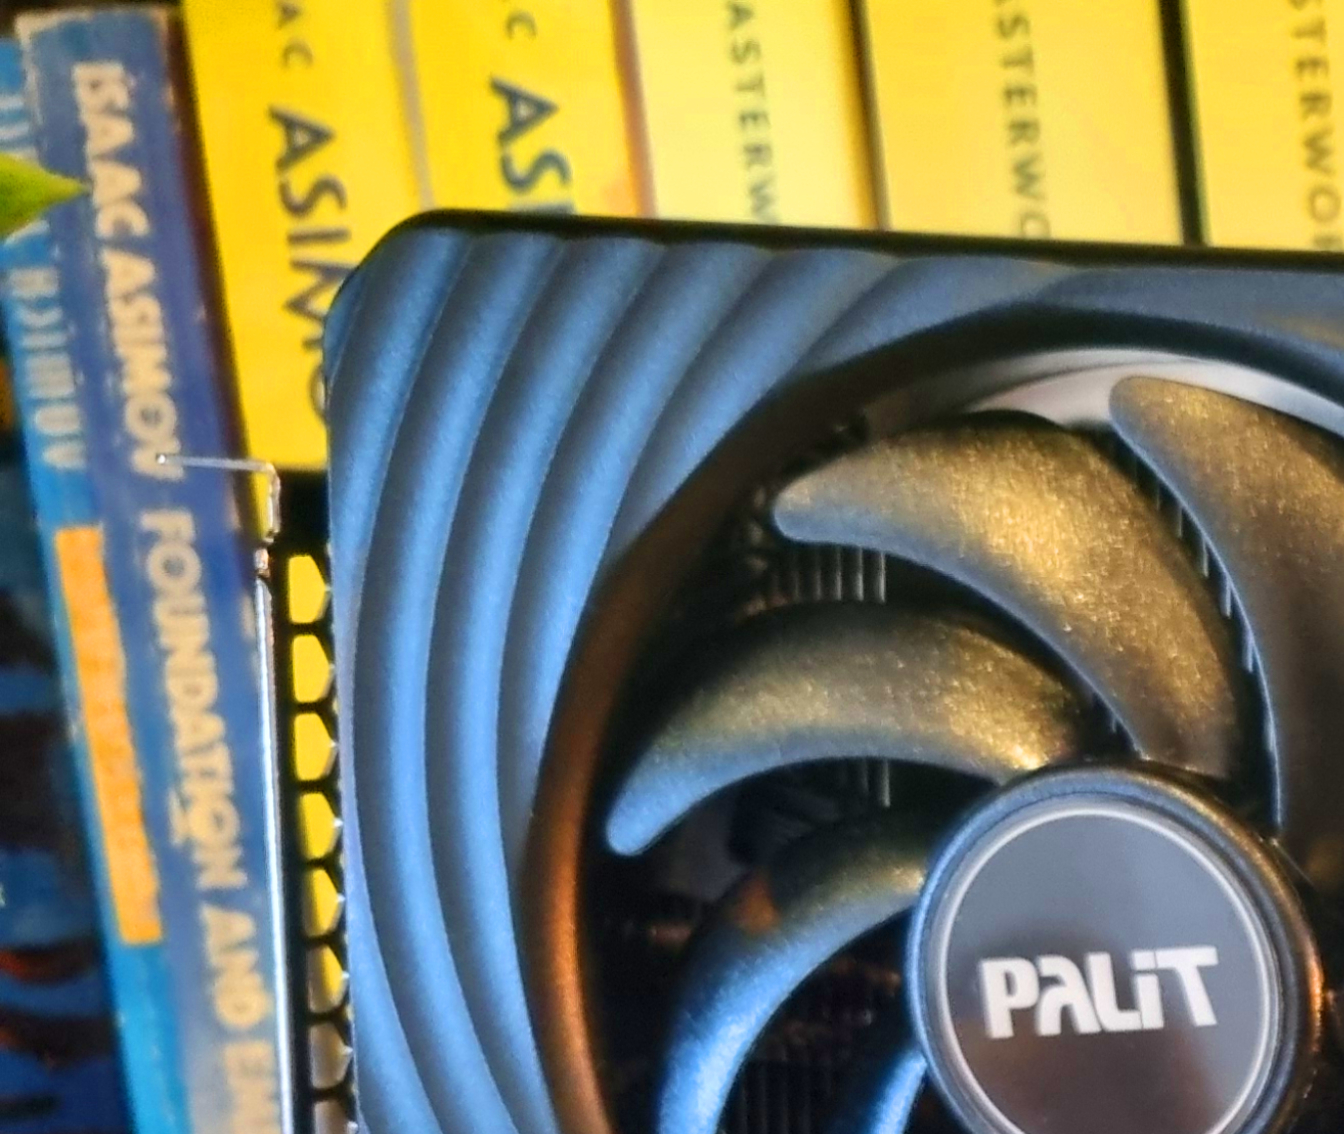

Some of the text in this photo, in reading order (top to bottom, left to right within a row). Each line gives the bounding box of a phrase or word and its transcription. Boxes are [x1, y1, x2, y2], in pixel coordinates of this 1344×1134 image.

[73, 61, 184, 482] ISAAC ASIMOV
[994, 0, 1051, 238] STERWO
[140, 508, 248, 889] FOUNDATION
[203, 906, 272, 1031] AND
